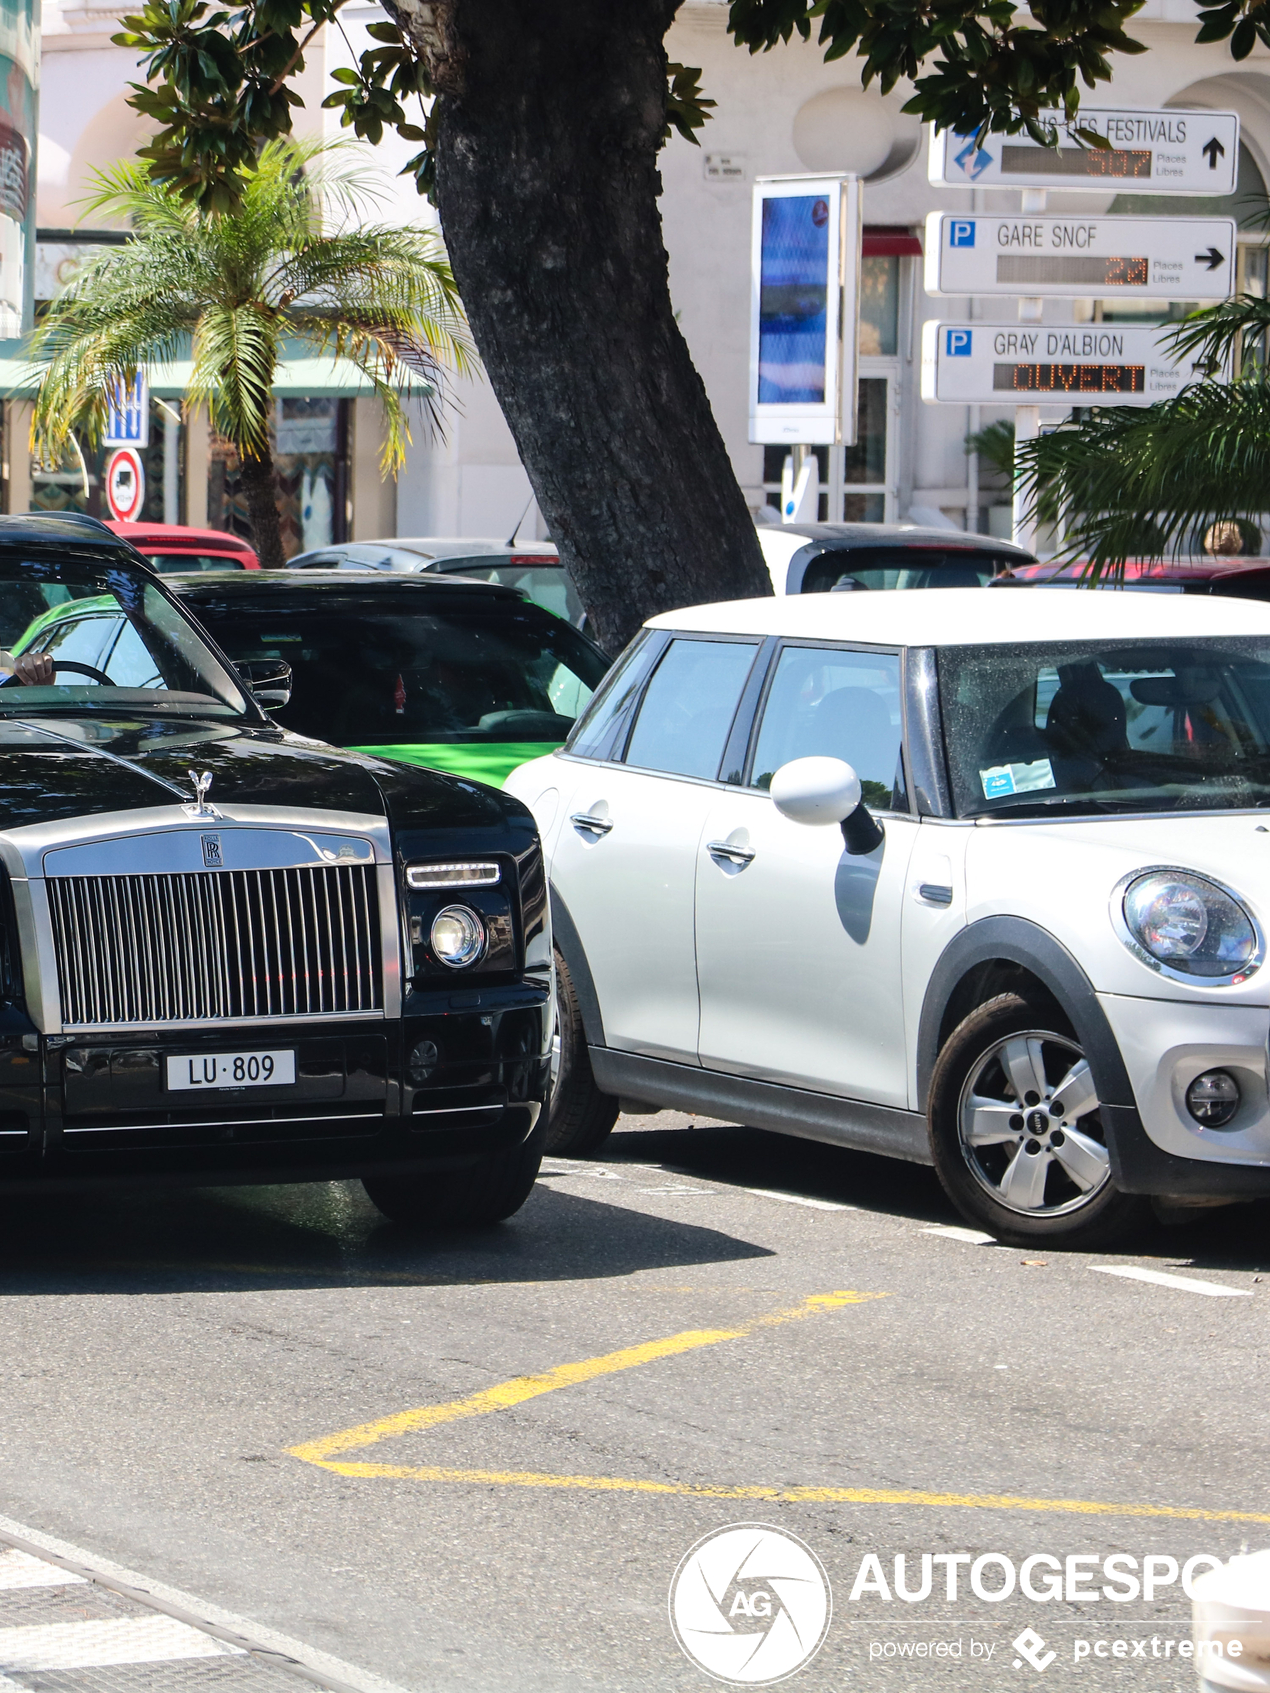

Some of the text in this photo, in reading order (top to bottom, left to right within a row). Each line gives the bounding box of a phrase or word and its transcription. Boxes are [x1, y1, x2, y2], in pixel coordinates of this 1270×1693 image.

[1107, 118, 1187, 144] FESTIVALS
[1087, 149, 1151, 178] 507
[1156, 153, 1187, 165] Places
[1156, 167, 1184, 178] Libres
[997, 224, 1043, 248] GARE
[1052, 225, 1098, 249] SNCF
[1152, 261, 1184, 272] Places
[1152, 275, 1181, 285] Libres
[993, 333, 1039, 356] GRAY
[1047, 334, 1124, 358] D'ALBION
[1013, 363, 1145, 393] OUVERT
[1149, 368, 1180, 380] Places
[1149, 382, 1178, 393] Libres
